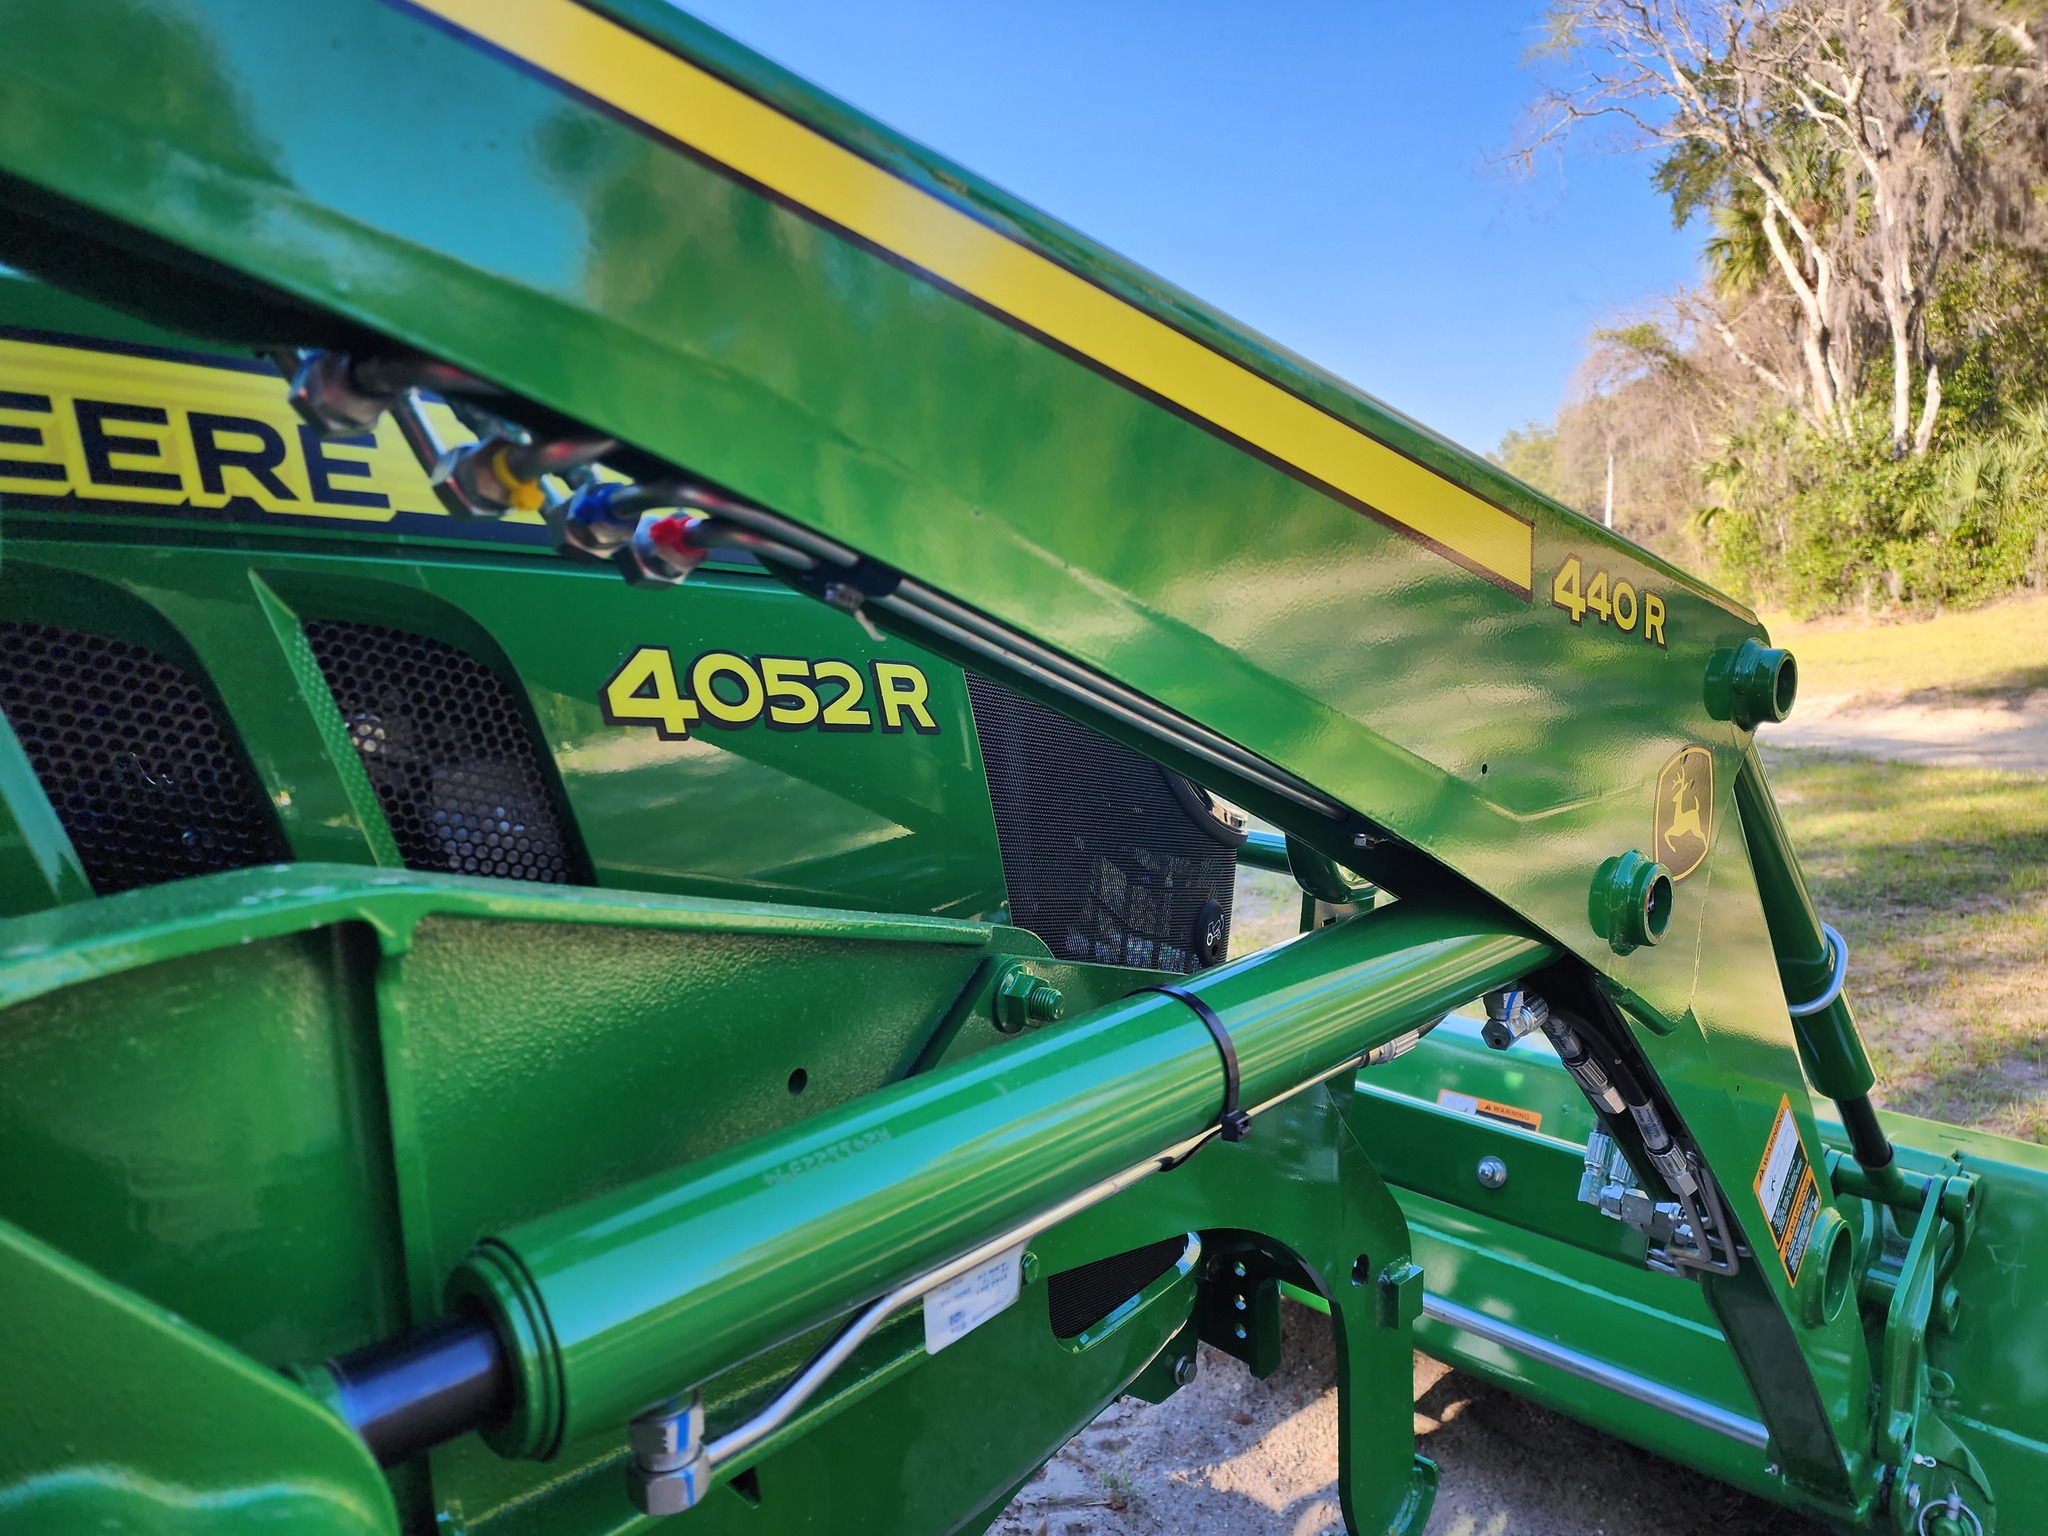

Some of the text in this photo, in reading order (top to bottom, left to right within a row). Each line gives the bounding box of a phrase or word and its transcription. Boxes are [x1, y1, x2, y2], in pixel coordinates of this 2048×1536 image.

[1493, 1105, 1530, 1121] WARNING
[1763, 1107, 1785, 1166] WARNING
[1789, 1177, 1810, 1234] WARNING
